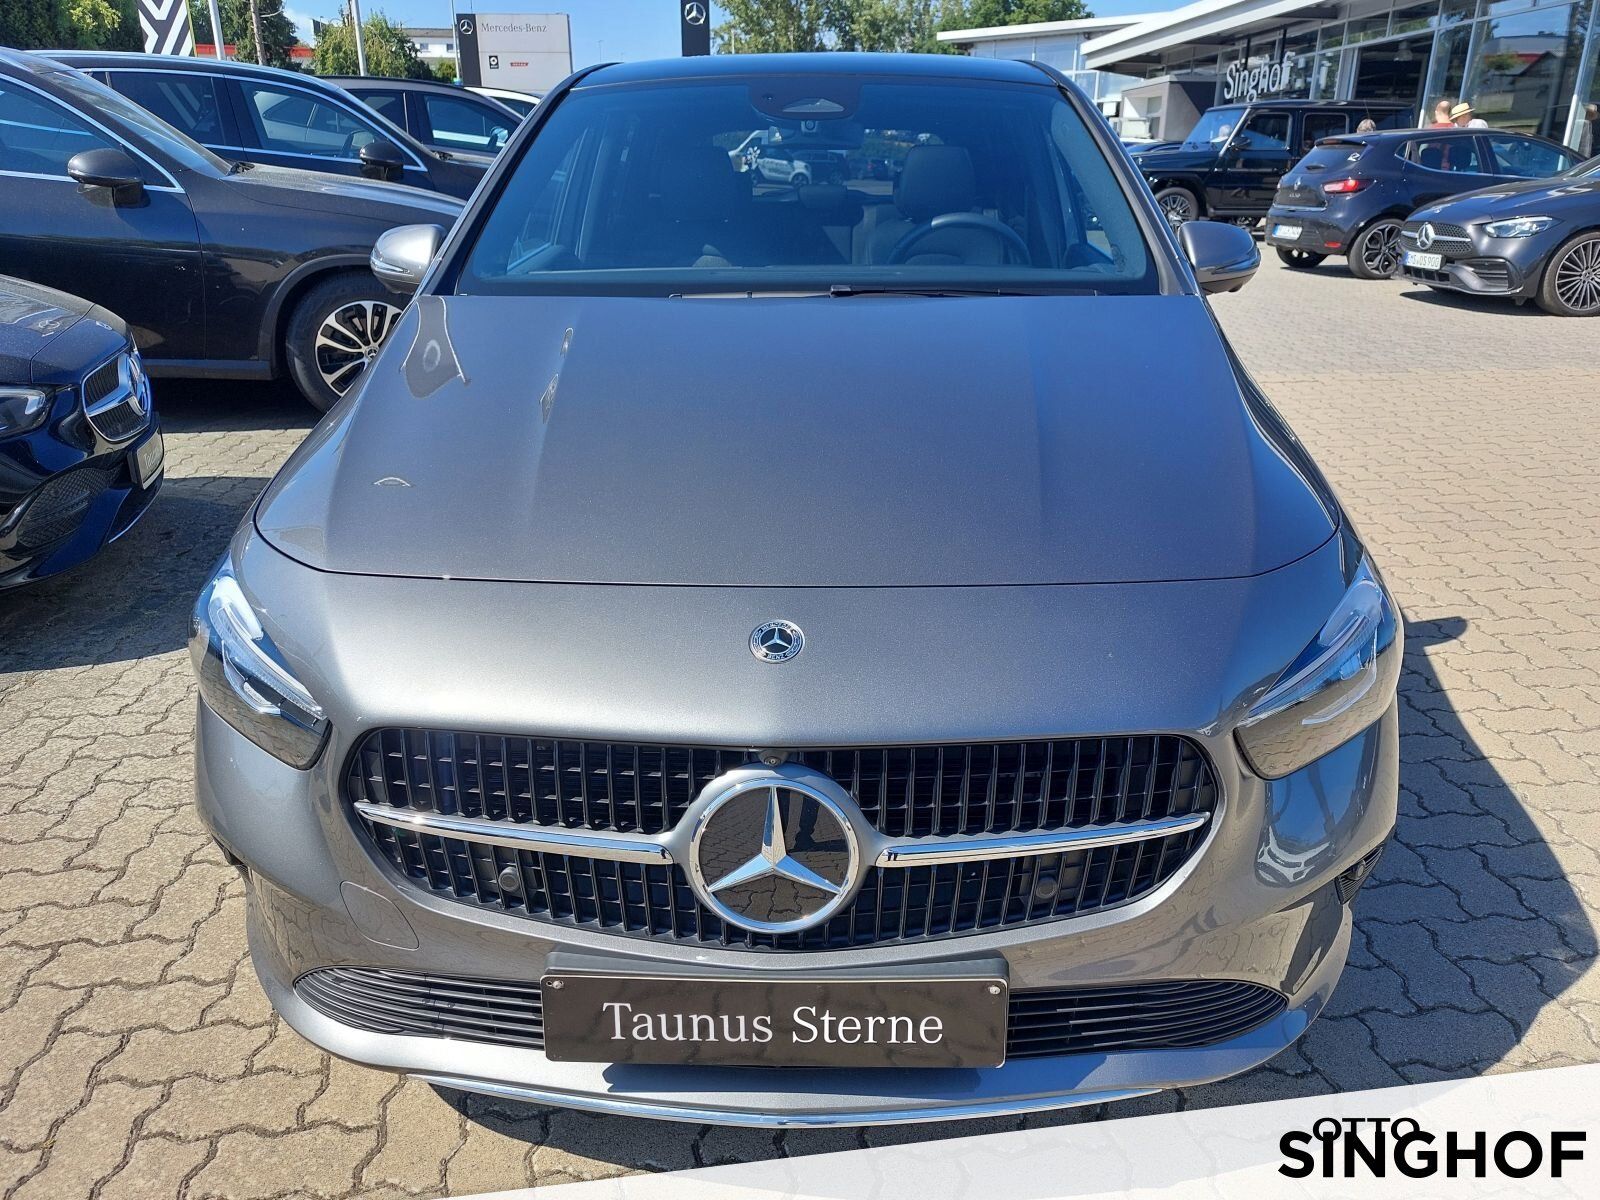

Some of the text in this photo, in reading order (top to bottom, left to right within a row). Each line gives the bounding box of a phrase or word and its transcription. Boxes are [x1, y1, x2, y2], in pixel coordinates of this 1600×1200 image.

[481, 23, 547, 33] Mercedes-Benz
[1224, 51, 1296, 103] Singhof
[602, 1002, 944, 1044] Taunus Sterne
